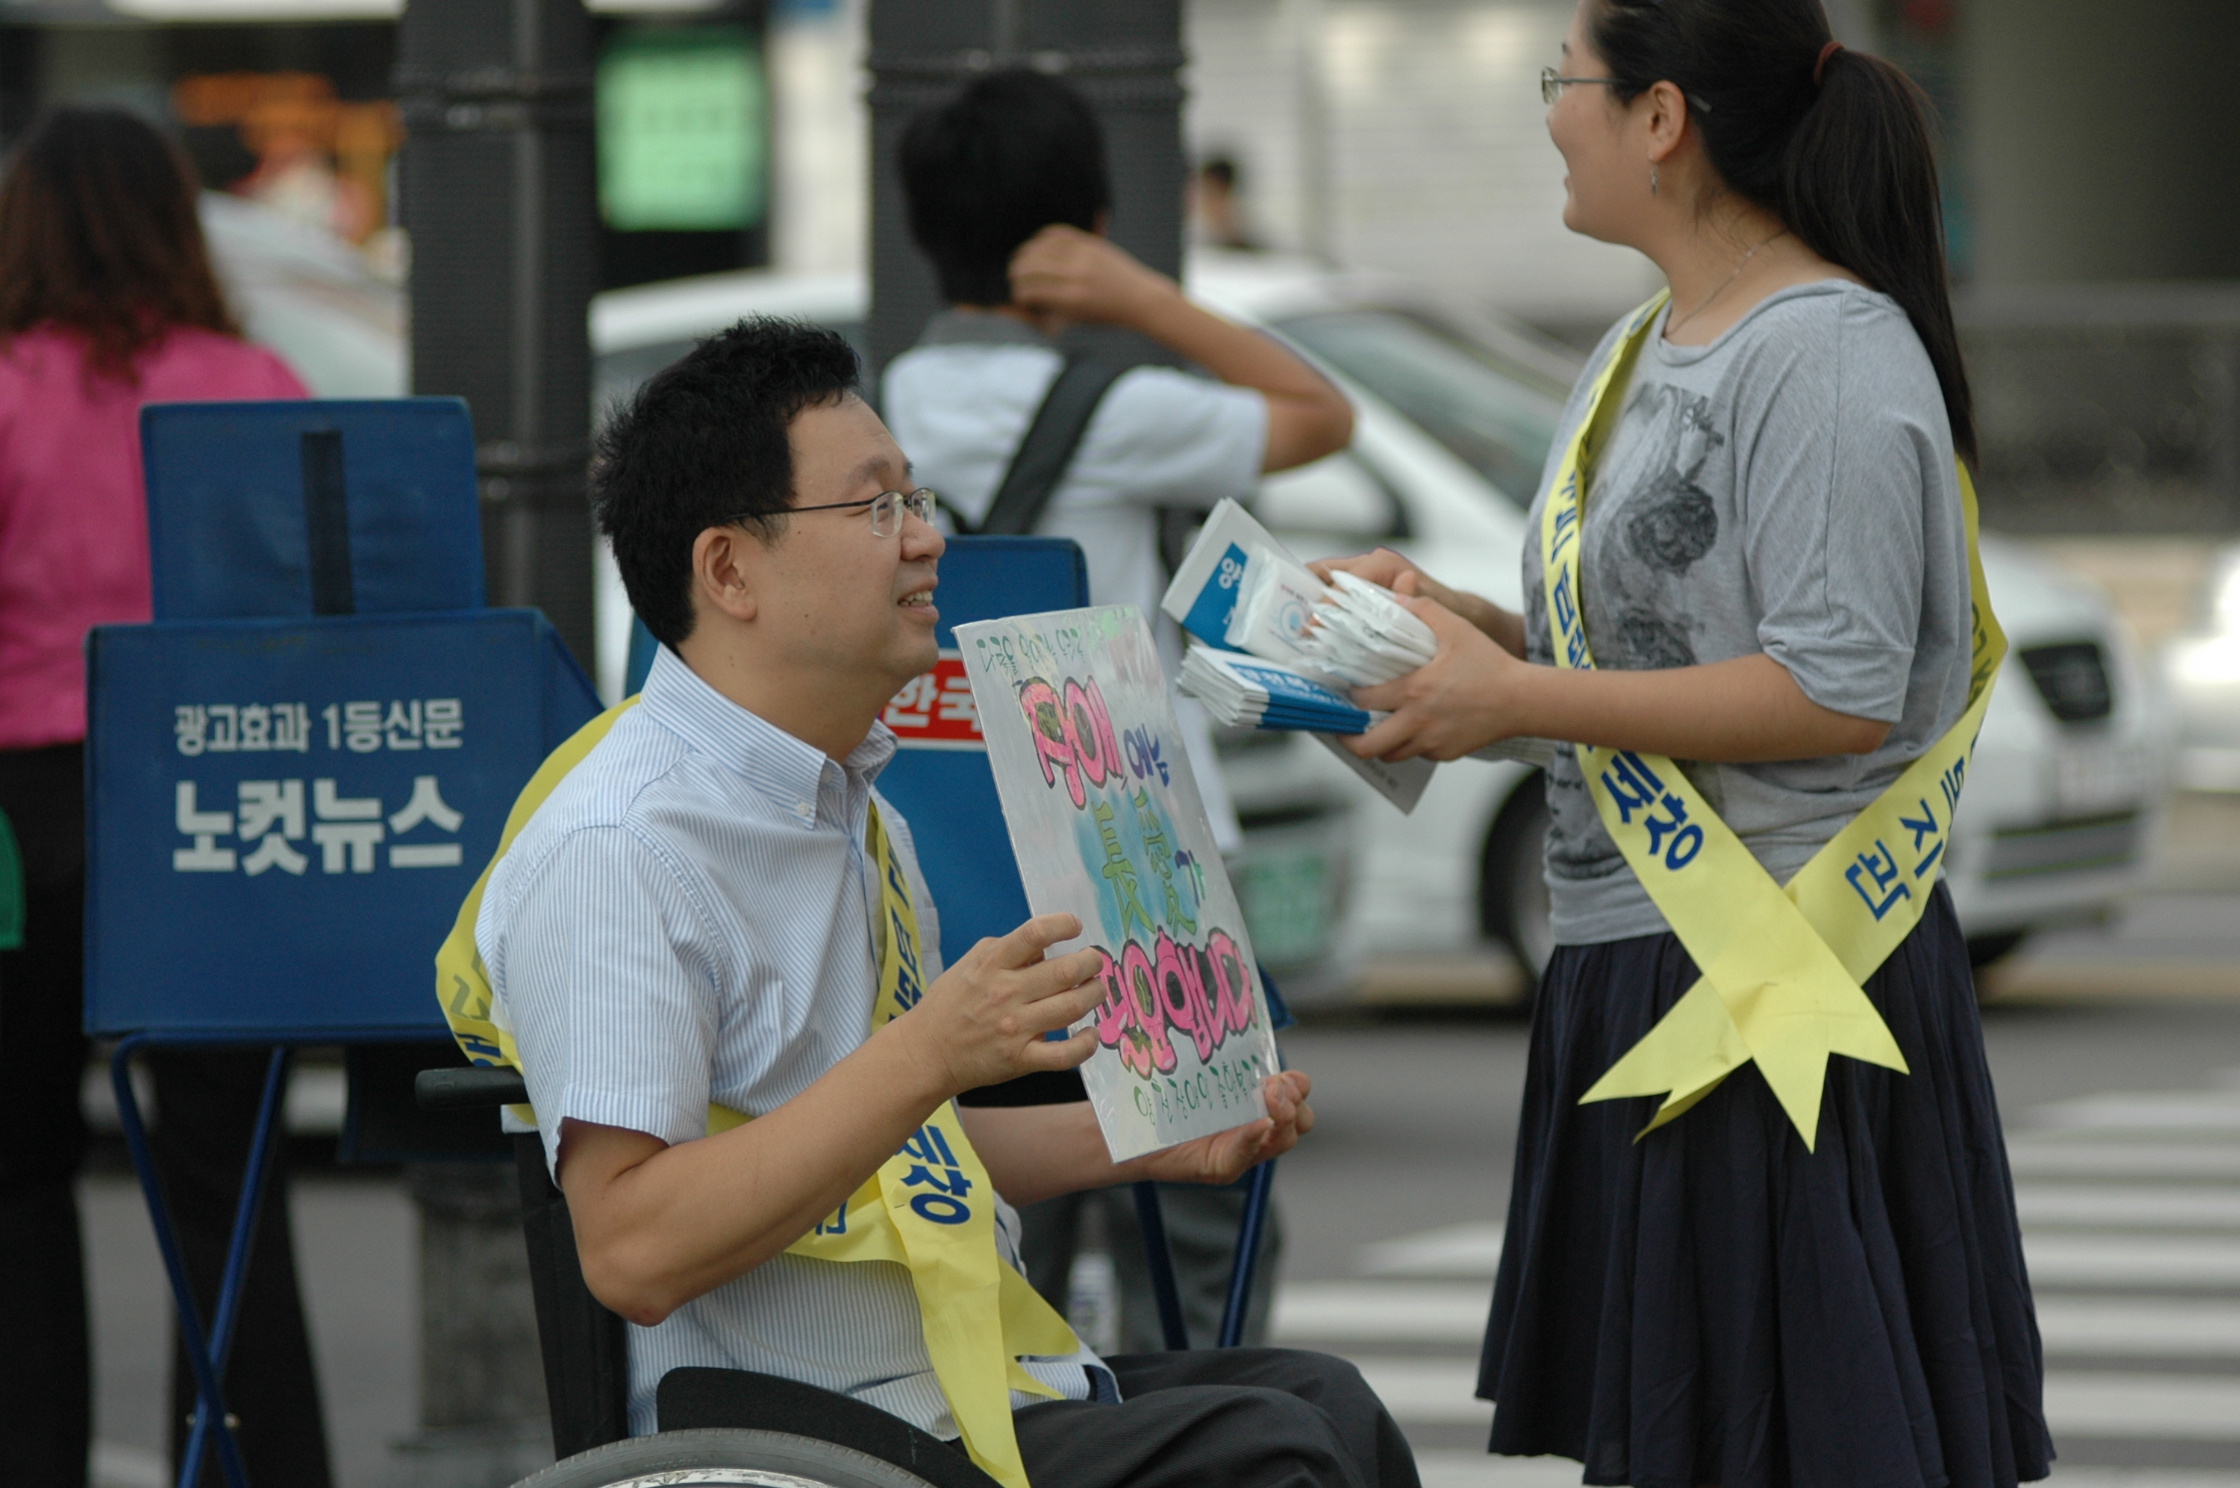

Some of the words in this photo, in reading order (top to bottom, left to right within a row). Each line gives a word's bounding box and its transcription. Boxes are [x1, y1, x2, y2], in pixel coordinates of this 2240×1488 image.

[175, 703, 311, 756] 광고효과
[322, 698, 465, 752] 1등신문
[172, 775, 465, 876] 노컷뉴스
[1601, 749, 1704, 871] 세상
[894, 1124, 974, 1226] 세상
